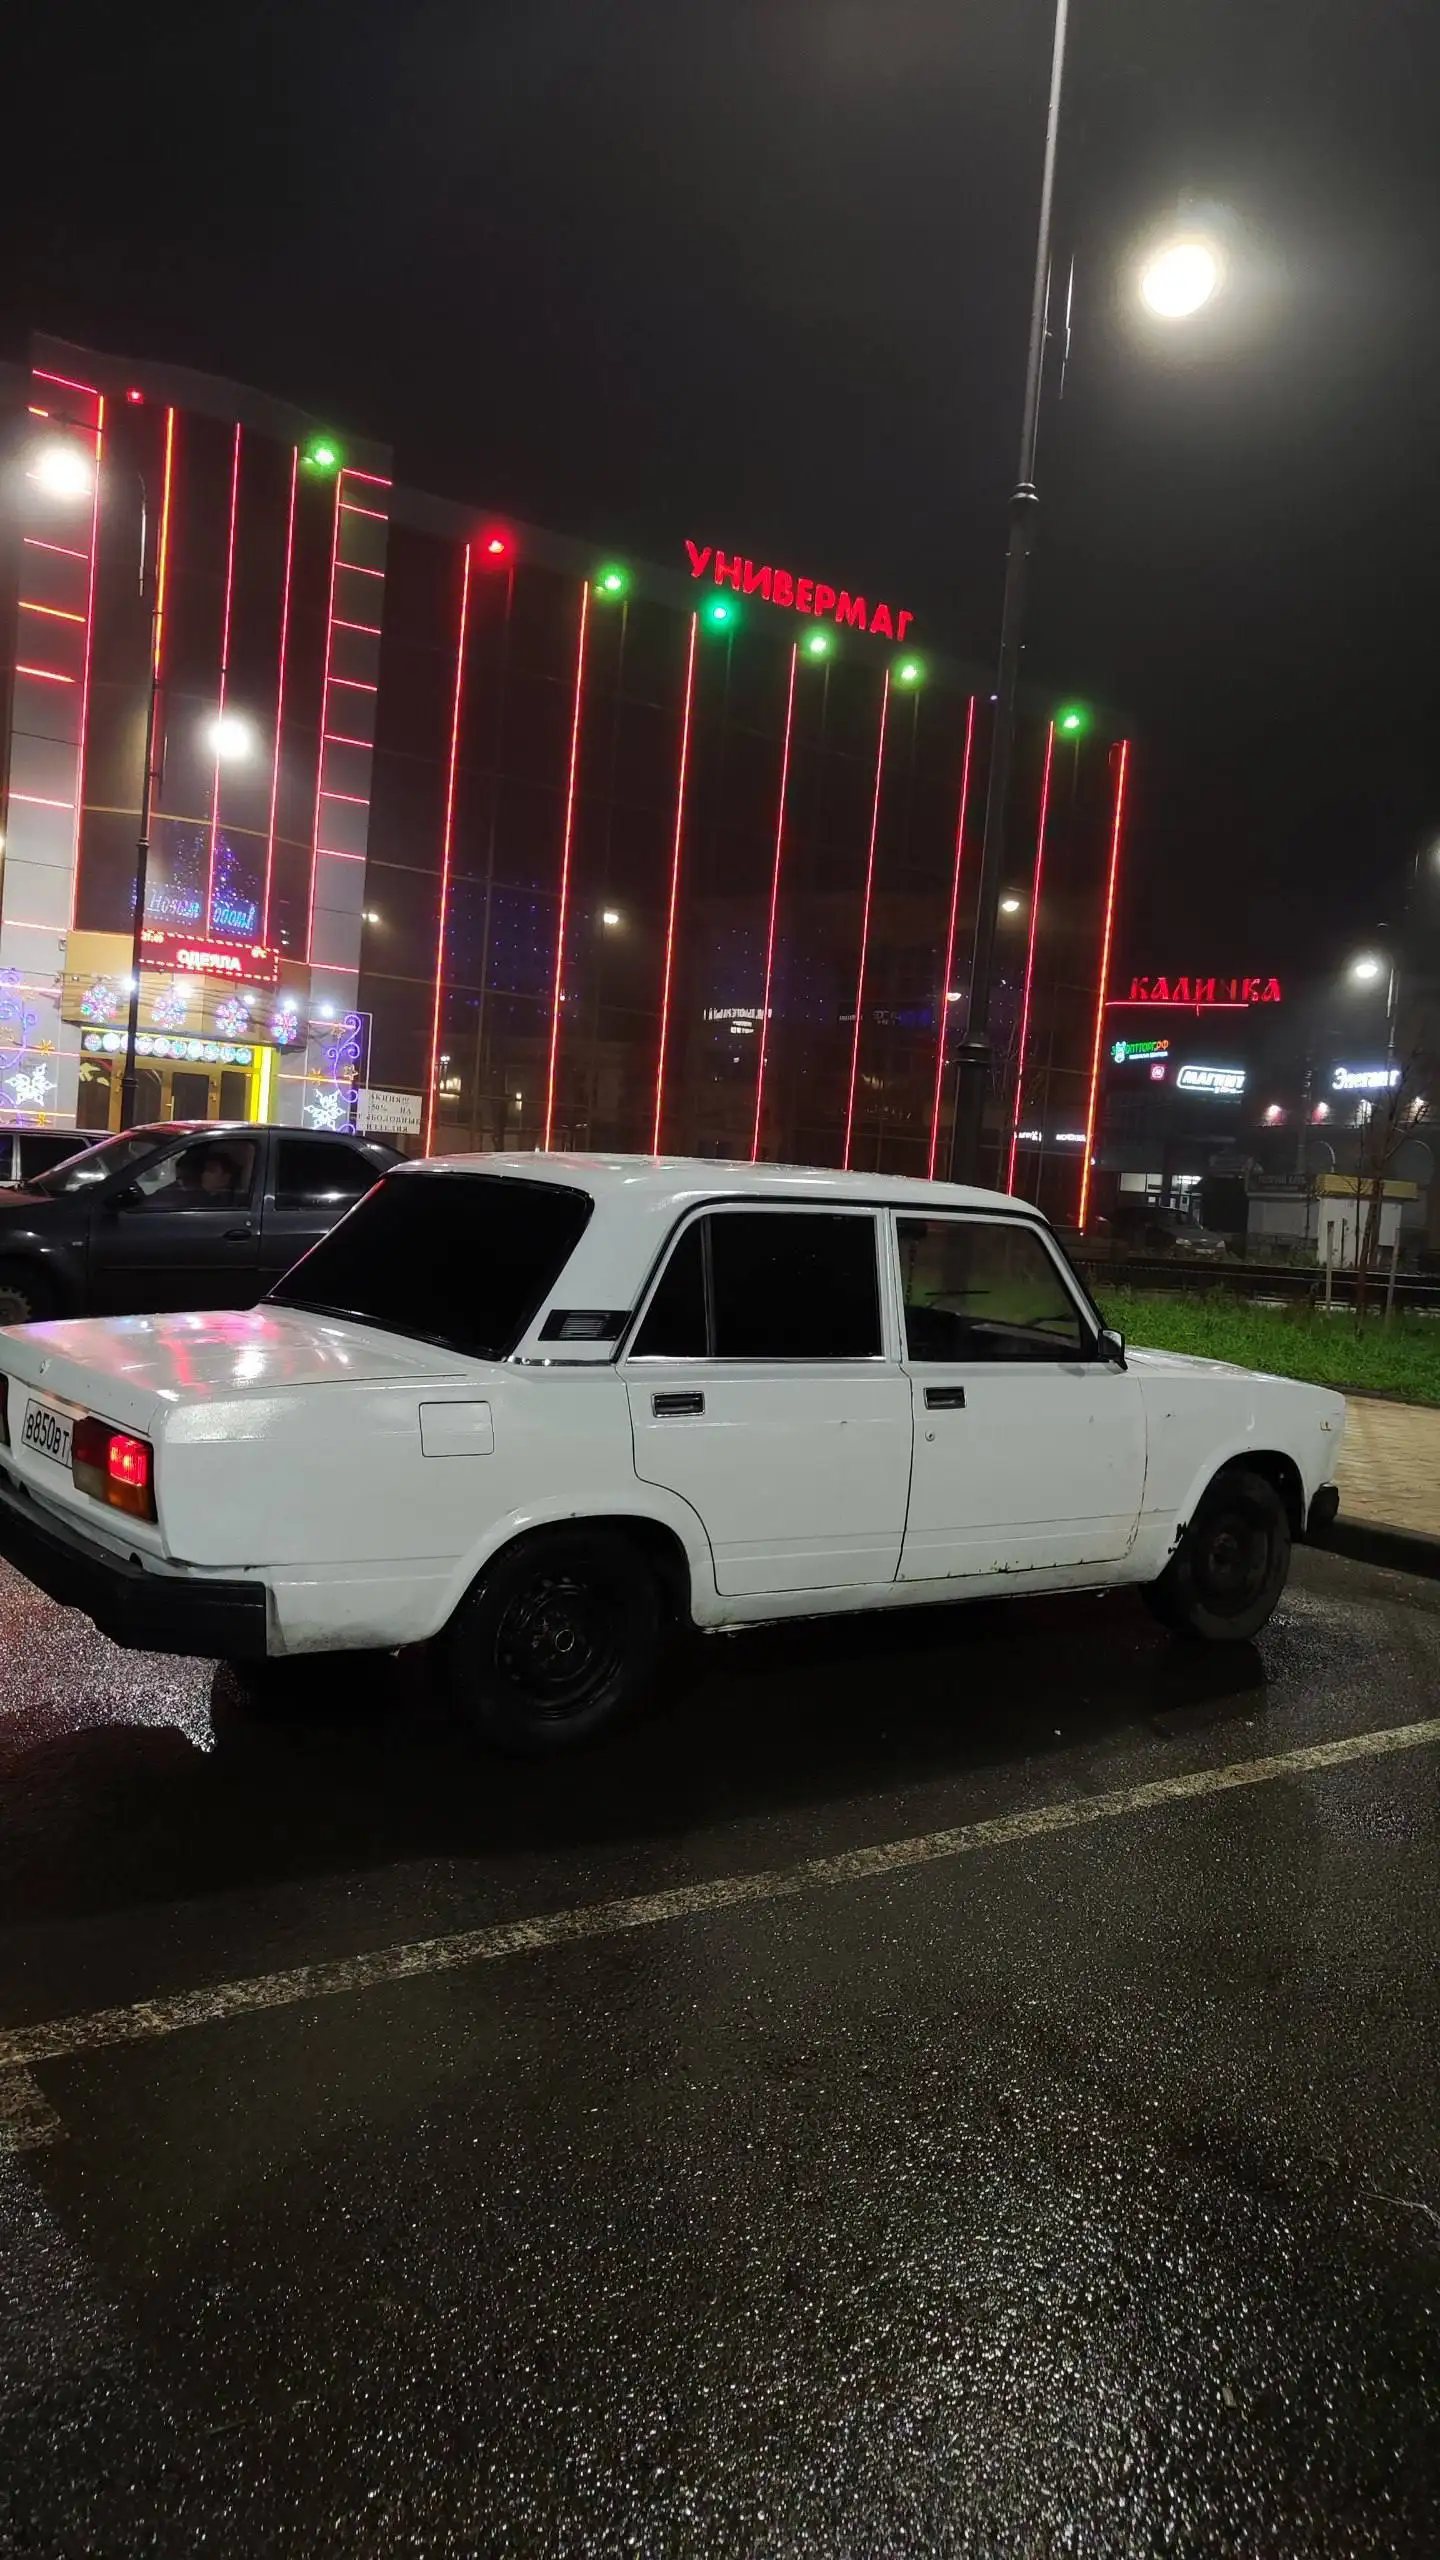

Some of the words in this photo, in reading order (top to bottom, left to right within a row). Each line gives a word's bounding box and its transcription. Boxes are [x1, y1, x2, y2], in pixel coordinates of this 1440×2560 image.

[684, 540, 914, 642] УНИВЕРМАГ
[176, 949, 242, 971] ОДЕЯЛА
[26, 1411, 69, 1458] В850ВТ
